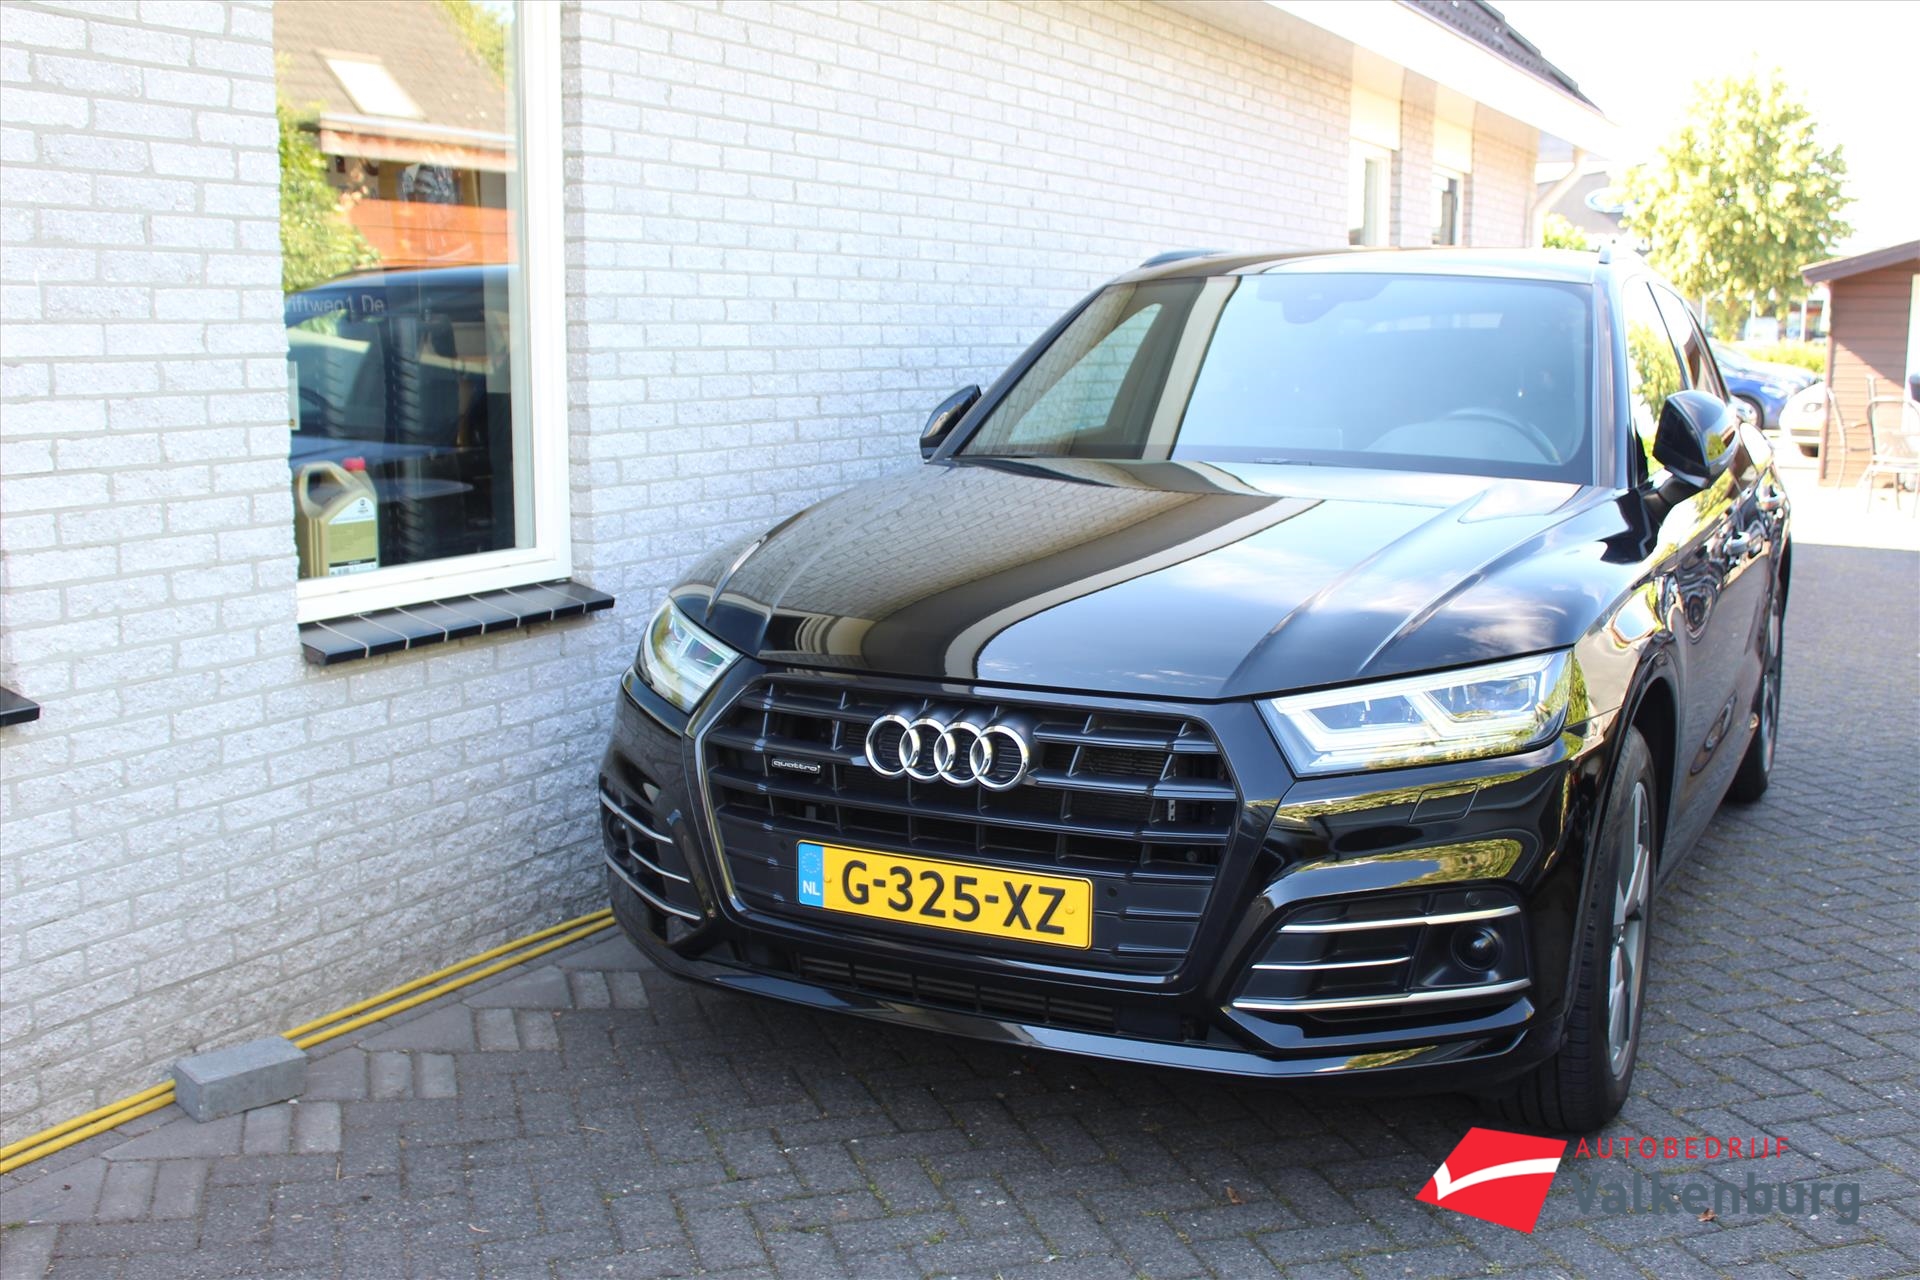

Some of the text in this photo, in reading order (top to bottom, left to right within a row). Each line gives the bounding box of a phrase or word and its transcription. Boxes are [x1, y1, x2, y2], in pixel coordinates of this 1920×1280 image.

[773, 760, 818, 772] quattro
[802, 881, 820, 896] NL
[841, 860, 1066, 936] G-325-XZ
